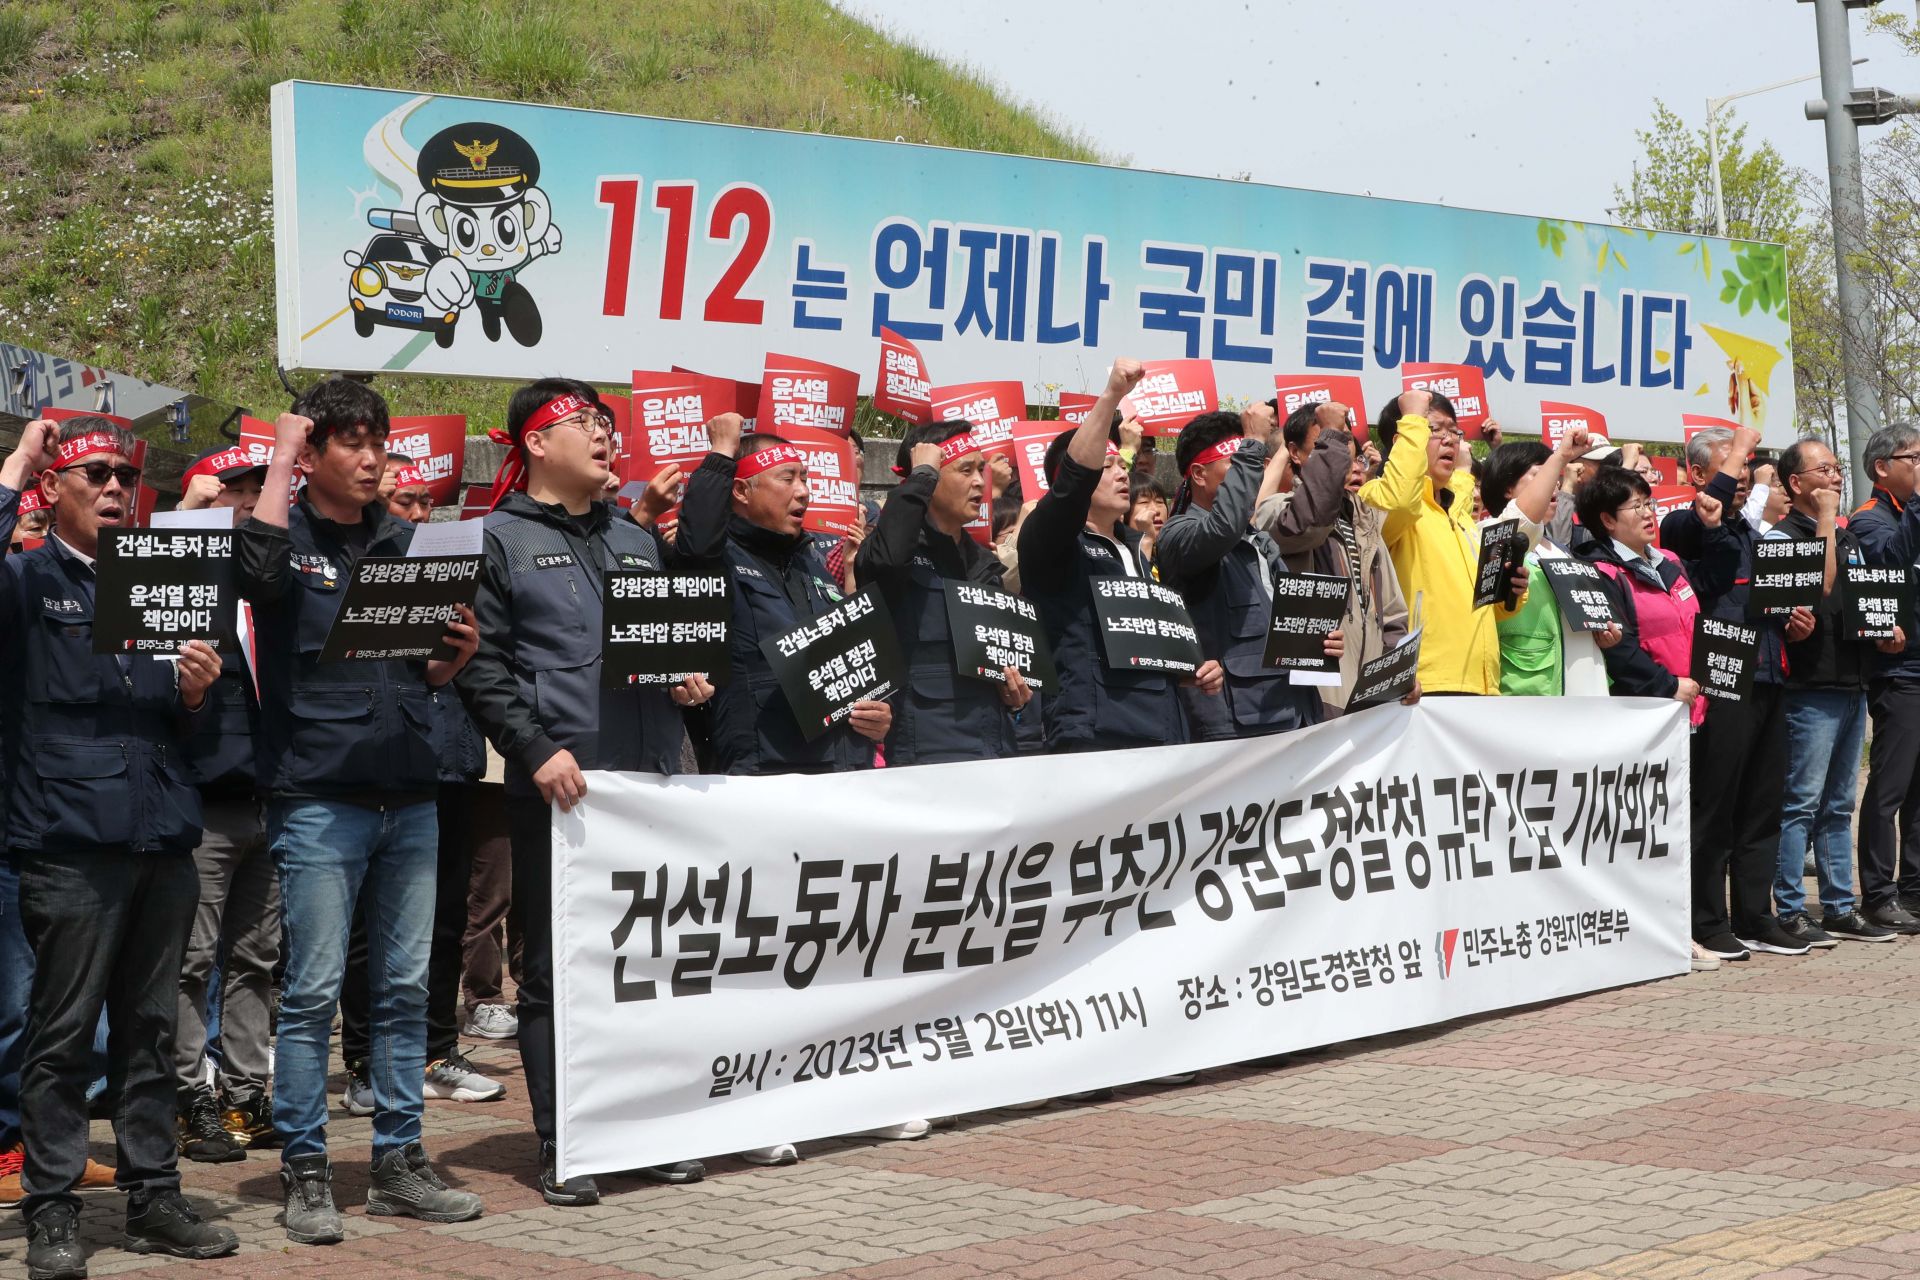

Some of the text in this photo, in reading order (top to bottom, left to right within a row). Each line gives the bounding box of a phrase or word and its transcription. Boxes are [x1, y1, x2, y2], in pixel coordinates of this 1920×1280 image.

[387, 307, 423, 320] PODORI
[871, 221, 1109, 347] 언제나
[1138, 246, 1276, 366] 국민
[1304, 261, 1432, 372] 곁에
[1458, 279, 1693, 390] 있습니다
[886, 350, 919, 377] 윤석열
[772, 377, 829, 403] 윤석열
[551, 394, 583, 415] 단결
[642, 395, 704, 427] 윤석열
[773, 403, 845, 430] 정권심판!
[1455, 396, 1481, 418] 심판!
[648, 424, 713, 456] 정권심
[971, 416, 1019, 447] 권심판
[61, 437, 88, 460] 단결
[212, 452, 238, 469] 단결
[755, 448, 785, 466] 단결
[418, 453, 453, 482] 심판!
[807, 478, 857, 507] 권심판!
[116, 535, 232, 557] 건설노동자 분신
[1757, 541, 1824, 558] 강원경찰 책임이다
[359, 560, 479, 584] 강원경찰 책임이다
[736, 566, 763, 577] 단결투
[1755, 571, 1823, 588] 노조탄압 중단하라
[1848, 568, 1905, 583] 건설노동자 분신
[129, 585, 218, 607] 윤석열 정권
[610, 576, 726, 598] 강원경찰 책임이다
[1098, 581, 1185, 610] 강원경찰 책임이다
[1279, 577, 1348, 600] 강원경찰 책임이다
[342, 606, 407, 625] 노조탄압
[957, 586, 1037, 621] 건설노동자 분신
[1858, 597, 1899, 612] 윤석열 정권
[142, 610, 212, 632] 책임이다
[609, 621, 727, 644] 노조탄압 중단하라
[776, 593, 875, 657] 건설노동자 분신
[1107, 617, 1198, 644] 노조탄압 중단하라
[1273, 616, 1339, 635] 노조탄압 중단하라
[1703, 620, 1756, 645] 건설노동자 분신
[1865, 613, 1896, 627] 책임이다
[975, 624, 1035, 654] 윤석열 정권
[808, 639, 877, 691] 윤석열 정권
[986, 645, 1031, 672] 책임이다
[1364, 652, 1402, 677] 강원경찰
[1707, 652, 1743, 674] 윤석열 정권
[823, 662, 877, 702] 책임이다
[1351, 677, 1393, 704] 노조탄압
[1710, 669, 1736, 688] 책임이다
[610, 757, 1670, 1004] 건설노동자 분신을 부추긴 강원도경찰청 규탄 긴급 기자회견
[1463, 907, 1631, 968] 민주노총 강원지역본부
[1178, 971, 1229, 1021] 장소
[1249, 946, 1395, 1008] 강원도경찰청
[1397, 938, 1423, 980] 앞
[708, 1049, 773, 1098] 일시
[793, 1029, 913, 1084] 2023년
[915, 1014, 974, 1062] 5월
[973, 999, 1084, 1053] 2일(화)
[1084, 985, 1148, 1034] 11시
